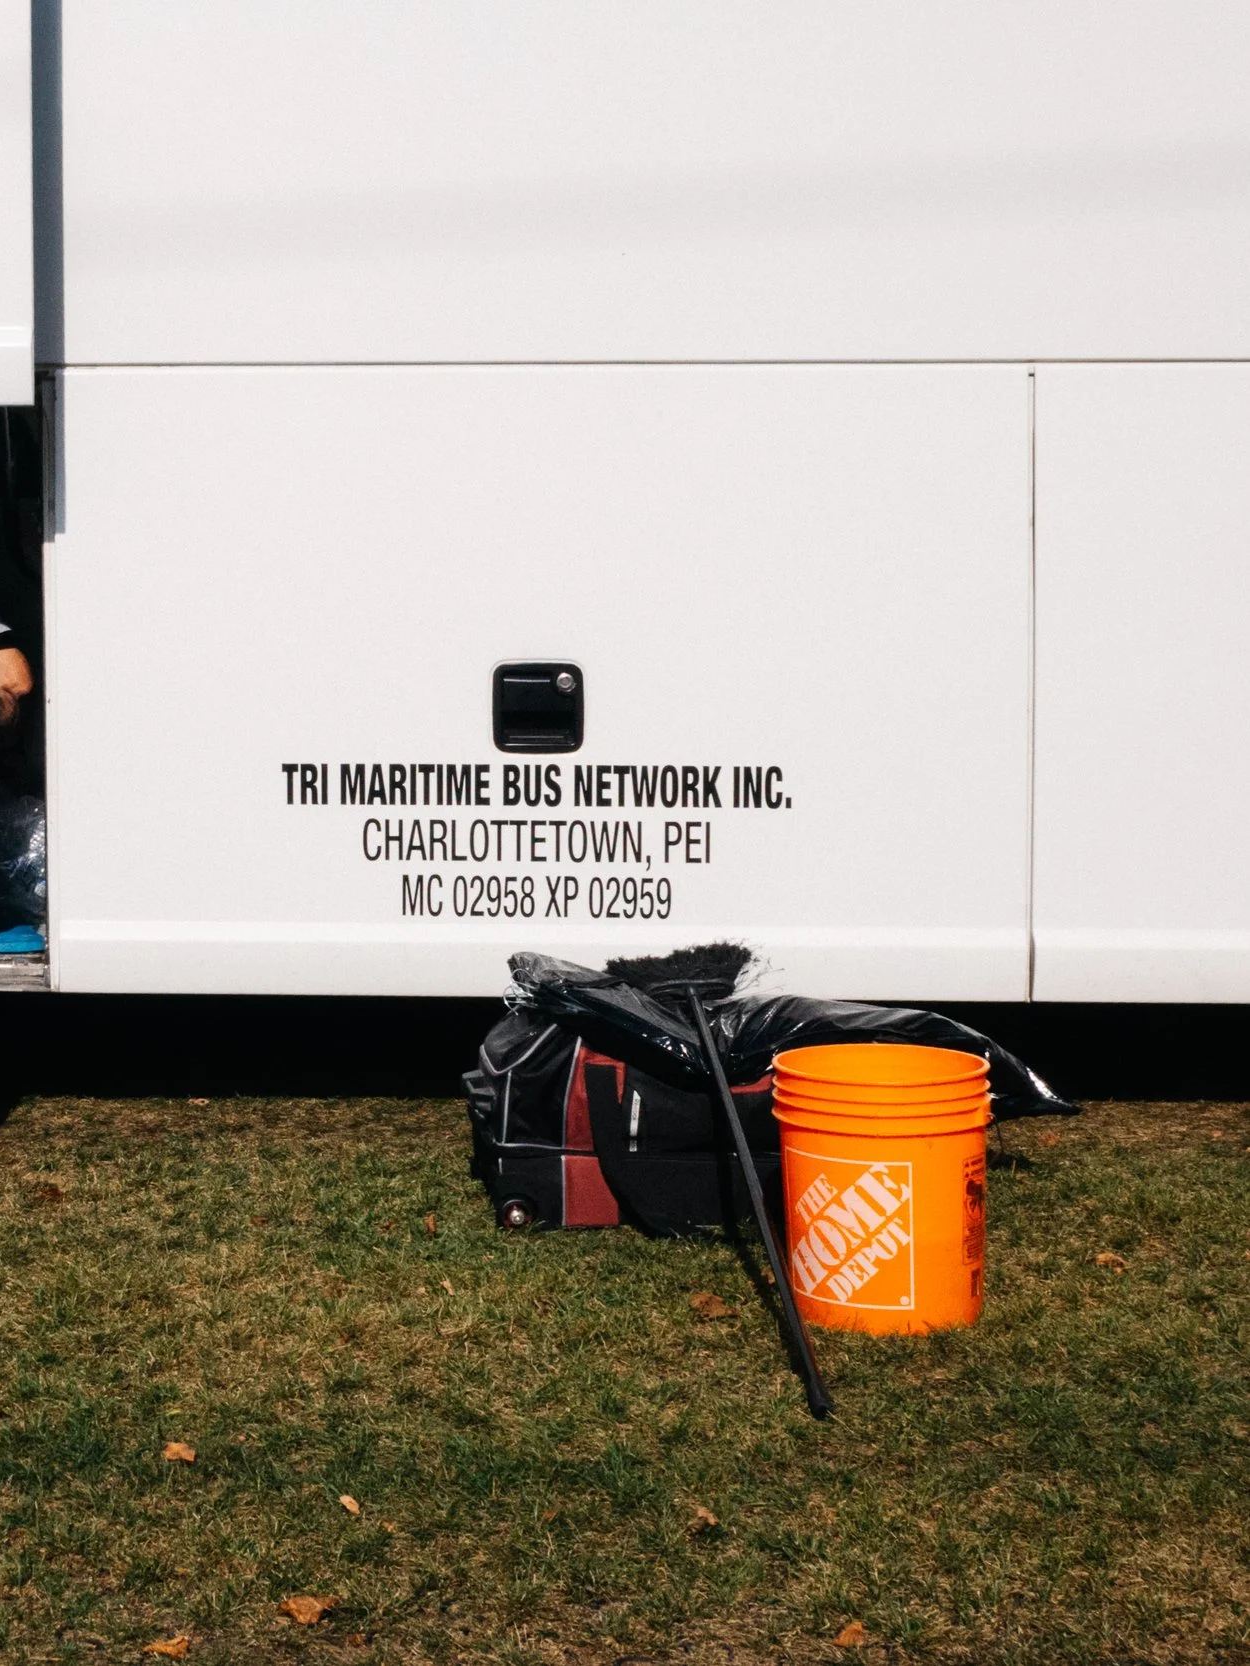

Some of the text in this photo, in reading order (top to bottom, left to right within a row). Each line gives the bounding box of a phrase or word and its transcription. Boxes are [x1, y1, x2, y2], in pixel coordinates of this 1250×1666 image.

[281, 763, 792, 809] TRI MARITIME BUS NETWORK INC.
[362, 819, 711, 871] CHARLOTTETOWN, PEI
[402, 874, 672, 920] MC 02958 XP 02959
[795, 1173, 838, 1225] THE
[792, 1164, 910, 1295] HOME
[826, 1217, 910, 1303] DEPOT
